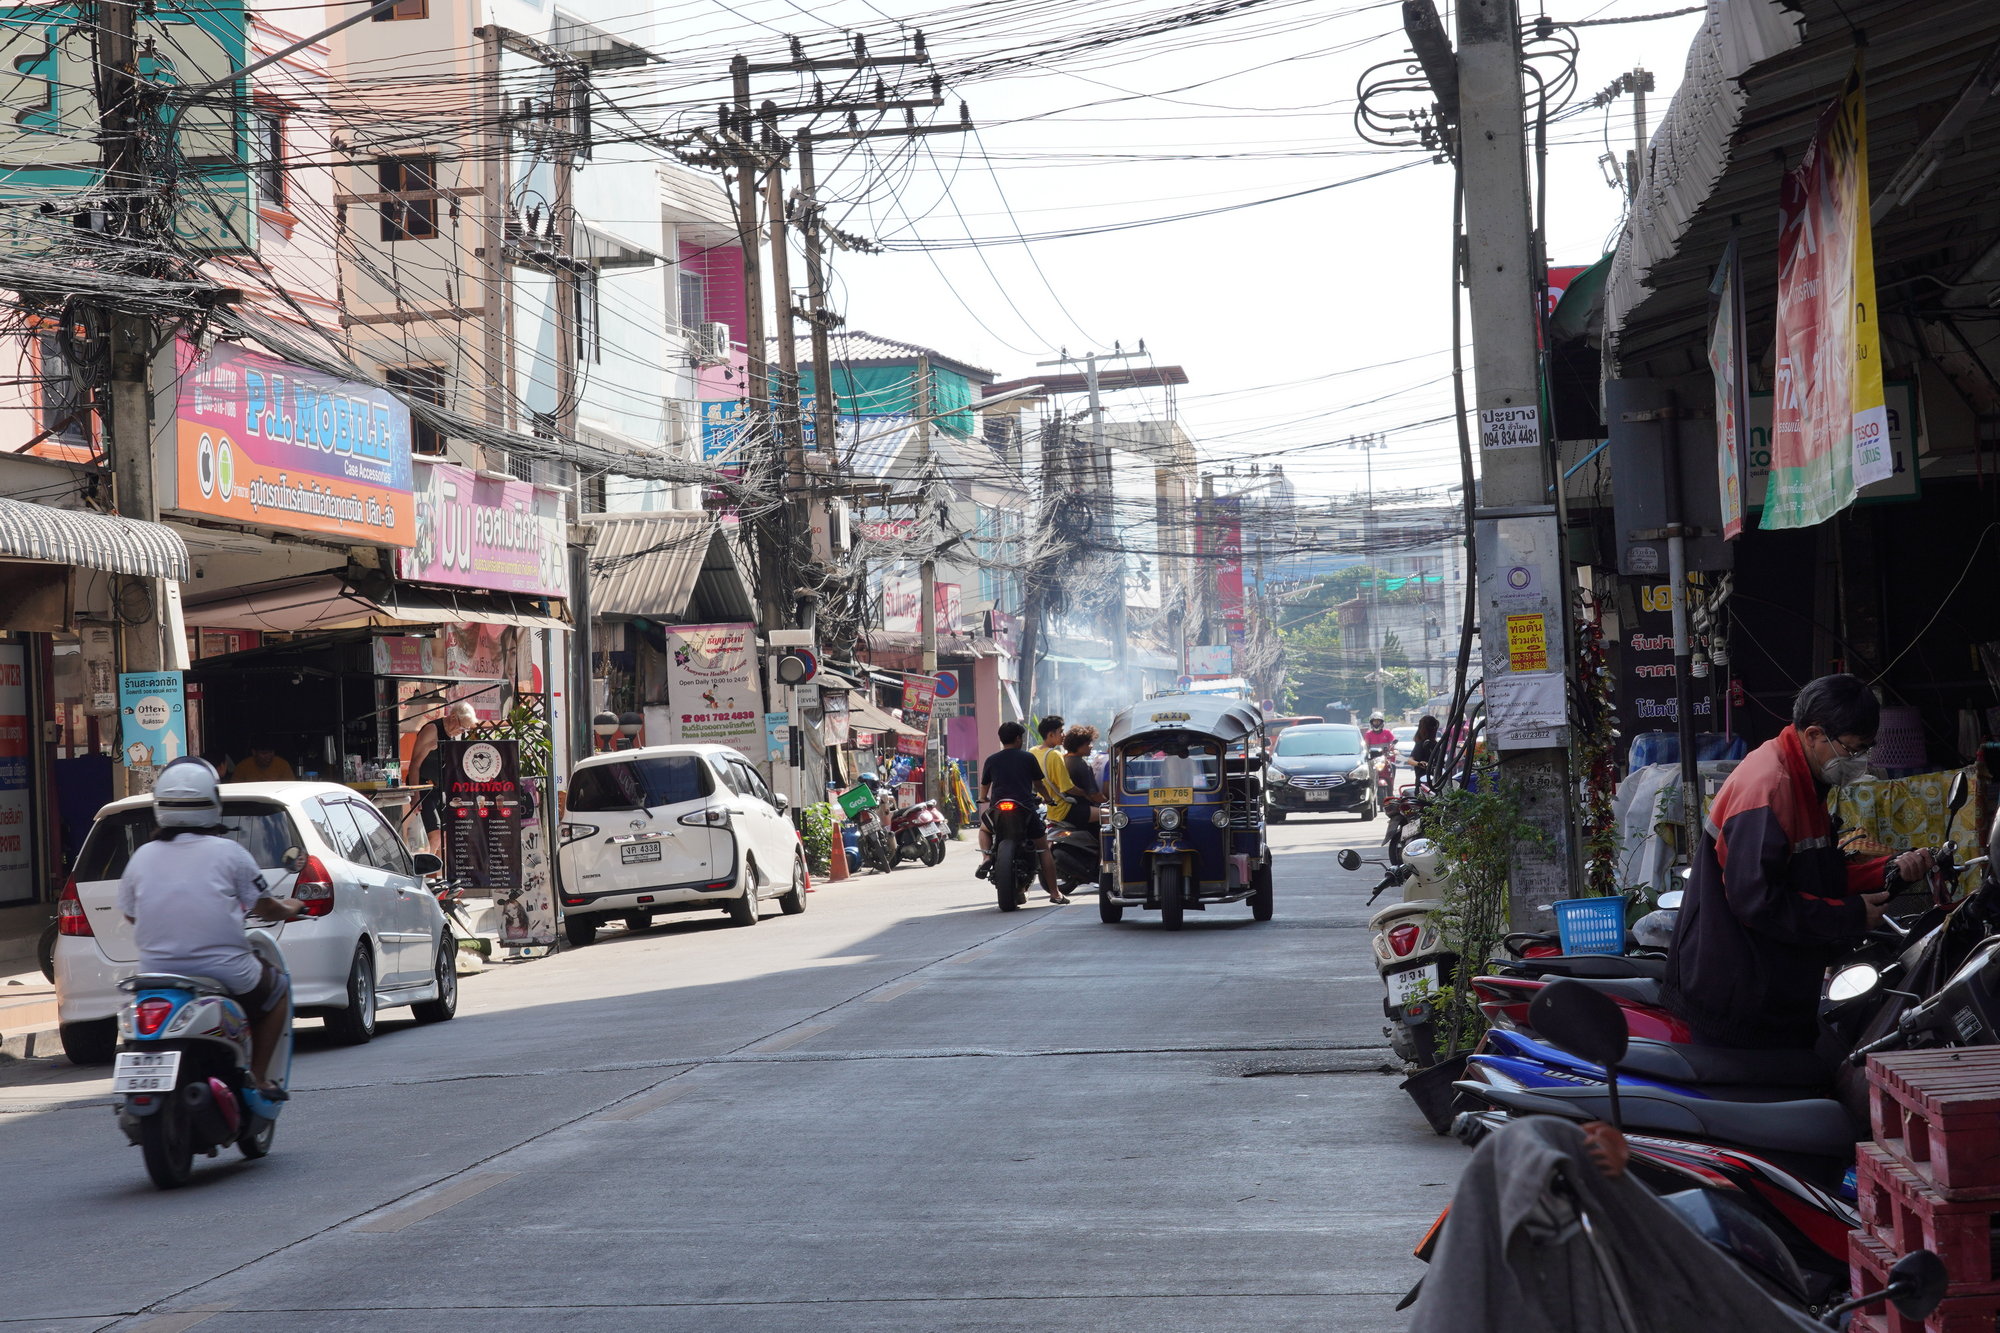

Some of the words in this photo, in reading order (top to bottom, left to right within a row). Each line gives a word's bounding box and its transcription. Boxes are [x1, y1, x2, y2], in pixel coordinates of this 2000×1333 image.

[1482, 409, 1536, 423] ปะยาง
[1491, 423, 1505, 431] 24
[1508, 422, 1528, 430] ชั่วโมง
[1854, 421, 1880, 442] TESCO
[1484, 431, 1499, 447] 094
[1501, 430, 1516, 446] 834
[1518, 428, 1538, 444] 4481
[1857, 446, 1881, 466] Lotus
[344, 460, 359, 476] Case
[359, 465, 391, 484] Accessories
[1509, 620, 1543, 634] ท่อตัน
[1510, 634, 1544, 646] ส้วมตัน
[124, 677, 178, 689] ร้านสะดวกซัก
[695, 677, 710, 685] Daily
[734, 675, 749, 683] 24:00
[904, 687, 918, 708] 5
[138, 704, 166, 714] Otteri
[727, 727, 757, 736] welcomed
[849, 796, 867, 809] Grab
[640, 844, 658, 852] 4338
